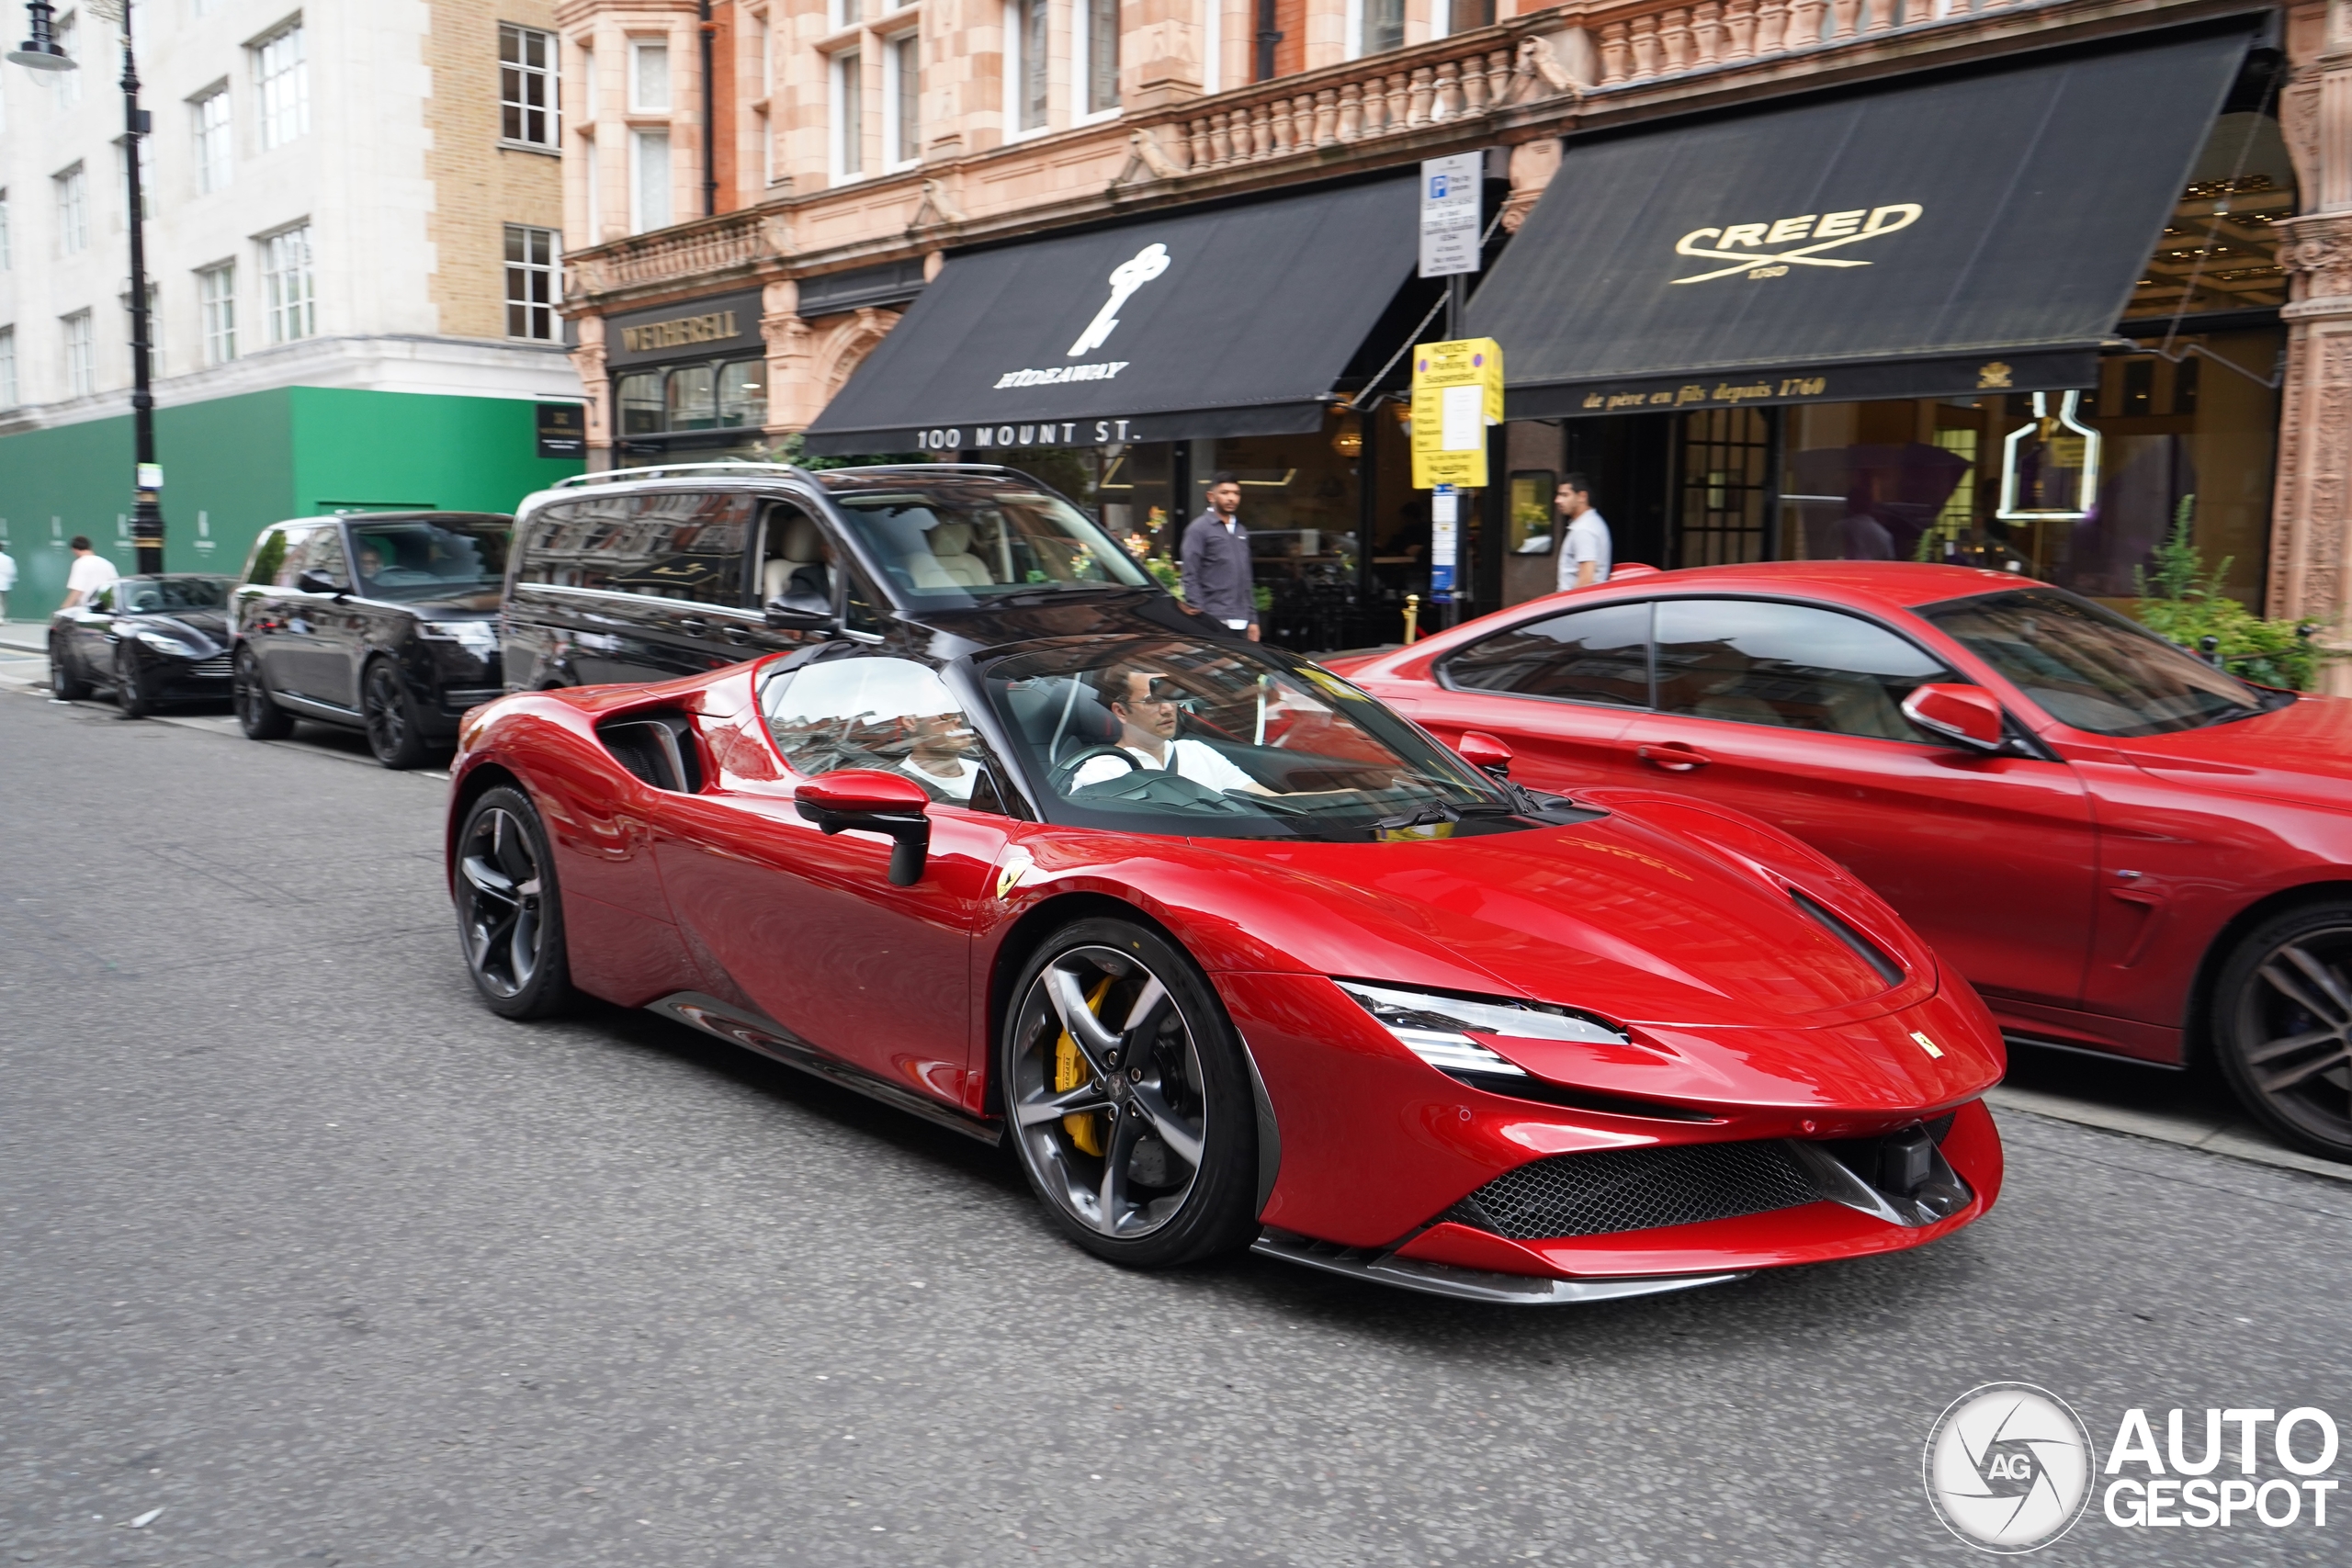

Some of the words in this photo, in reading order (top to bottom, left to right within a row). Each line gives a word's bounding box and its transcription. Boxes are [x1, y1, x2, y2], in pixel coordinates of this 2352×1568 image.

[1674, 203, 1923, 265] CREED
[620, 310, 742, 352] WETHERELL
[1432, 342, 1469, 355] NOTICE
[1582, 391, 1605, 409] de
[1648, 391, 1673, 404] en
[1673, 384, 1708, 407] fils
[1712, 379, 1773, 404] depuis
[1777, 377, 1826, 397] 1760
[917, 428, 961, 449] 100
[975, 423, 1077, 446] MOUNT
[1094, 420, 1142, 442] ST.
